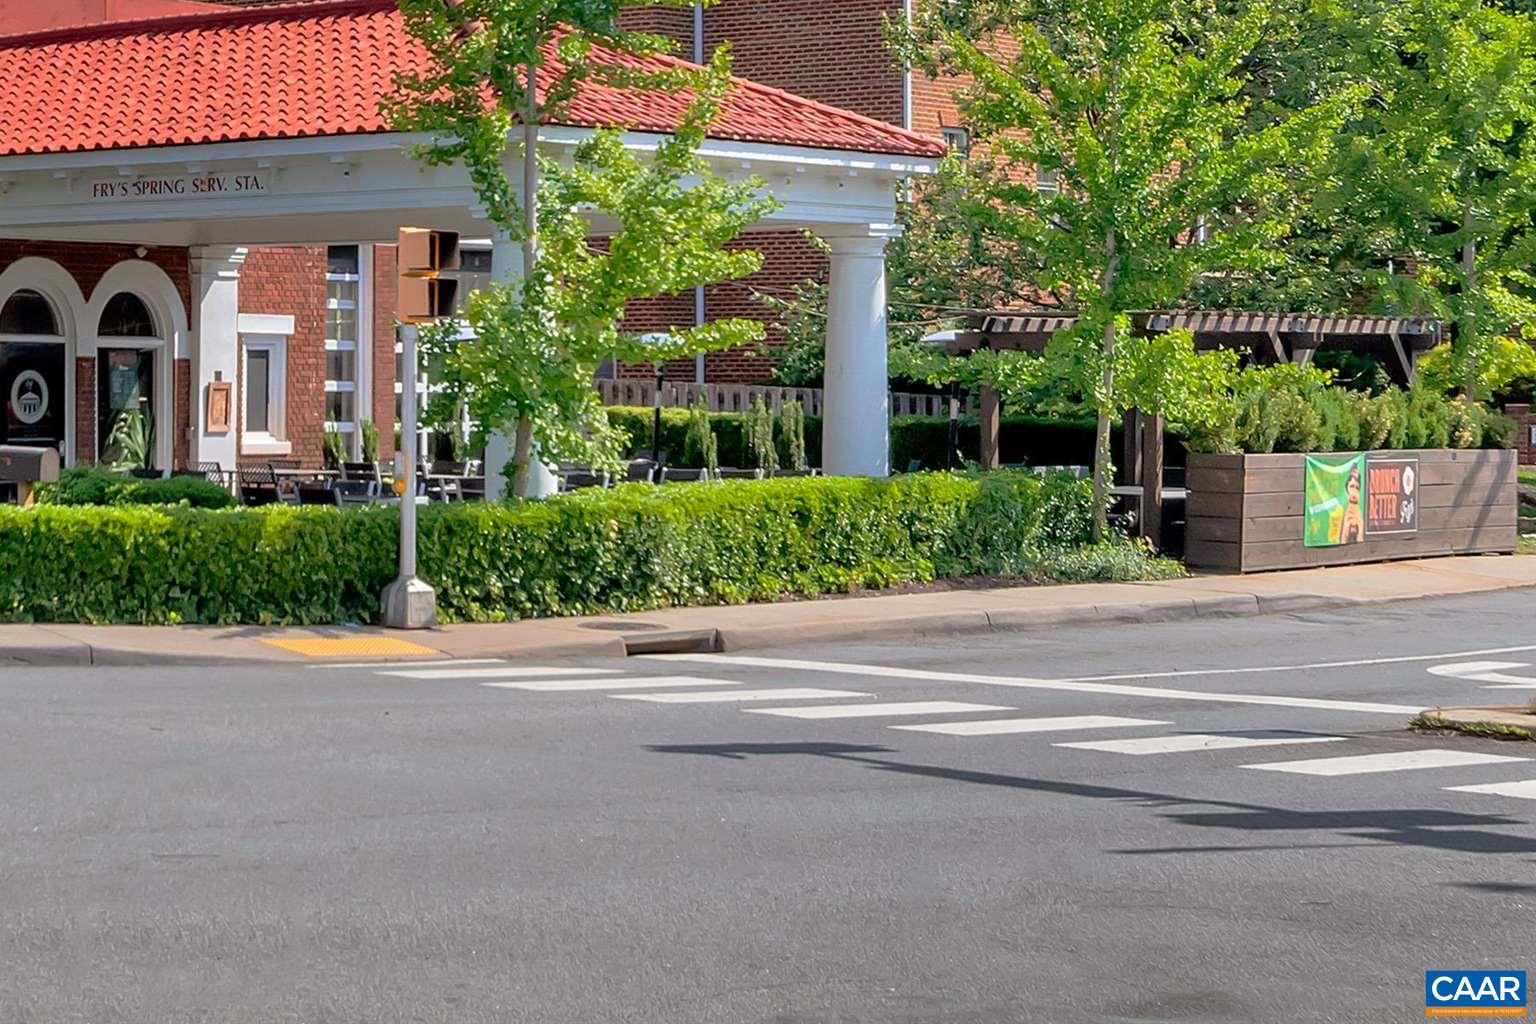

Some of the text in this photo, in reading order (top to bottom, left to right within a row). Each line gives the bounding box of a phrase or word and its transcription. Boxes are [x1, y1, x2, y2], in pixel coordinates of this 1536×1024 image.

[93, 182, 128, 197] FRY'S
[134, 179, 185, 195] SPRING
[235, 175, 264, 191] STA.
